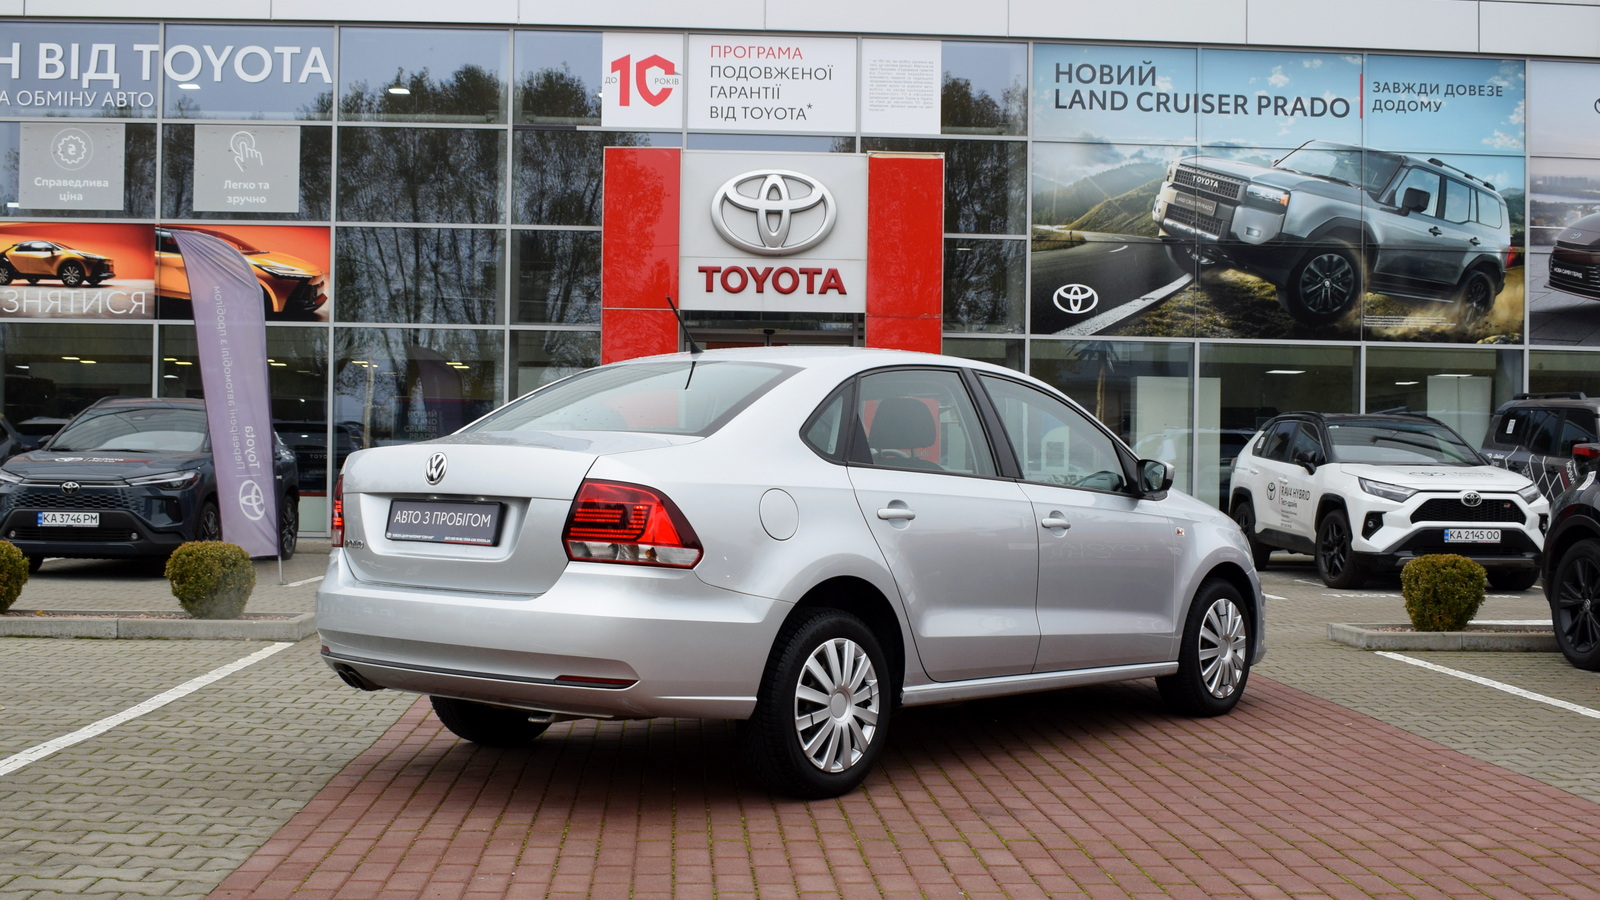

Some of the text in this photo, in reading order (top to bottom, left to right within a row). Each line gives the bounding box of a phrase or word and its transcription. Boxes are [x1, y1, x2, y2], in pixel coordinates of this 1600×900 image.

[710, 45, 803, 60] ПРОГРАМА
[38, 43, 120, 88] ВІД
[134, 44, 333, 84] TOYOTA
[710, 64, 833, 81] ПОДОВЖЕНОЇ
[1054, 60, 1156, 87] НОВИЙ
[604, 76, 618, 84] ДО
[710, 84, 781, 100] ГАРАНТІЇ
[1372, 81, 1504, 100] ЗАВЖДИ ДОВЕЗЕ
[16, 90, 96, 108] ОБМІНУ
[102, 92, 154, 108] АВТО
[1054, 89, 1350, 119] LAND CRUISER PRADO
[1372, 98, 1442, 115] ДОДОМУ
[710, 106, 736, 122] ВІД
[34, 177, 109, 190] Справедлива
[224, 180, 270, 190] Легко та
[1193, 176, 1218, 188] TOYOTA
[59, 190, 84, 204] ціна
[226, 194, 266, 206] зручно
[698, 266, 847, 295] TOYOTA
[2, 290, 146, 314] ЗНЯТИСЯ
[43, 513, 98, 524] KA 3746 PM
[394, 510, 422, 525] АВТО
[432, 512, 492, 527] ПРОБІГОМ
[1449, 530, 1464, 540] KA
[1465, 530, 1486, 540] 2145
